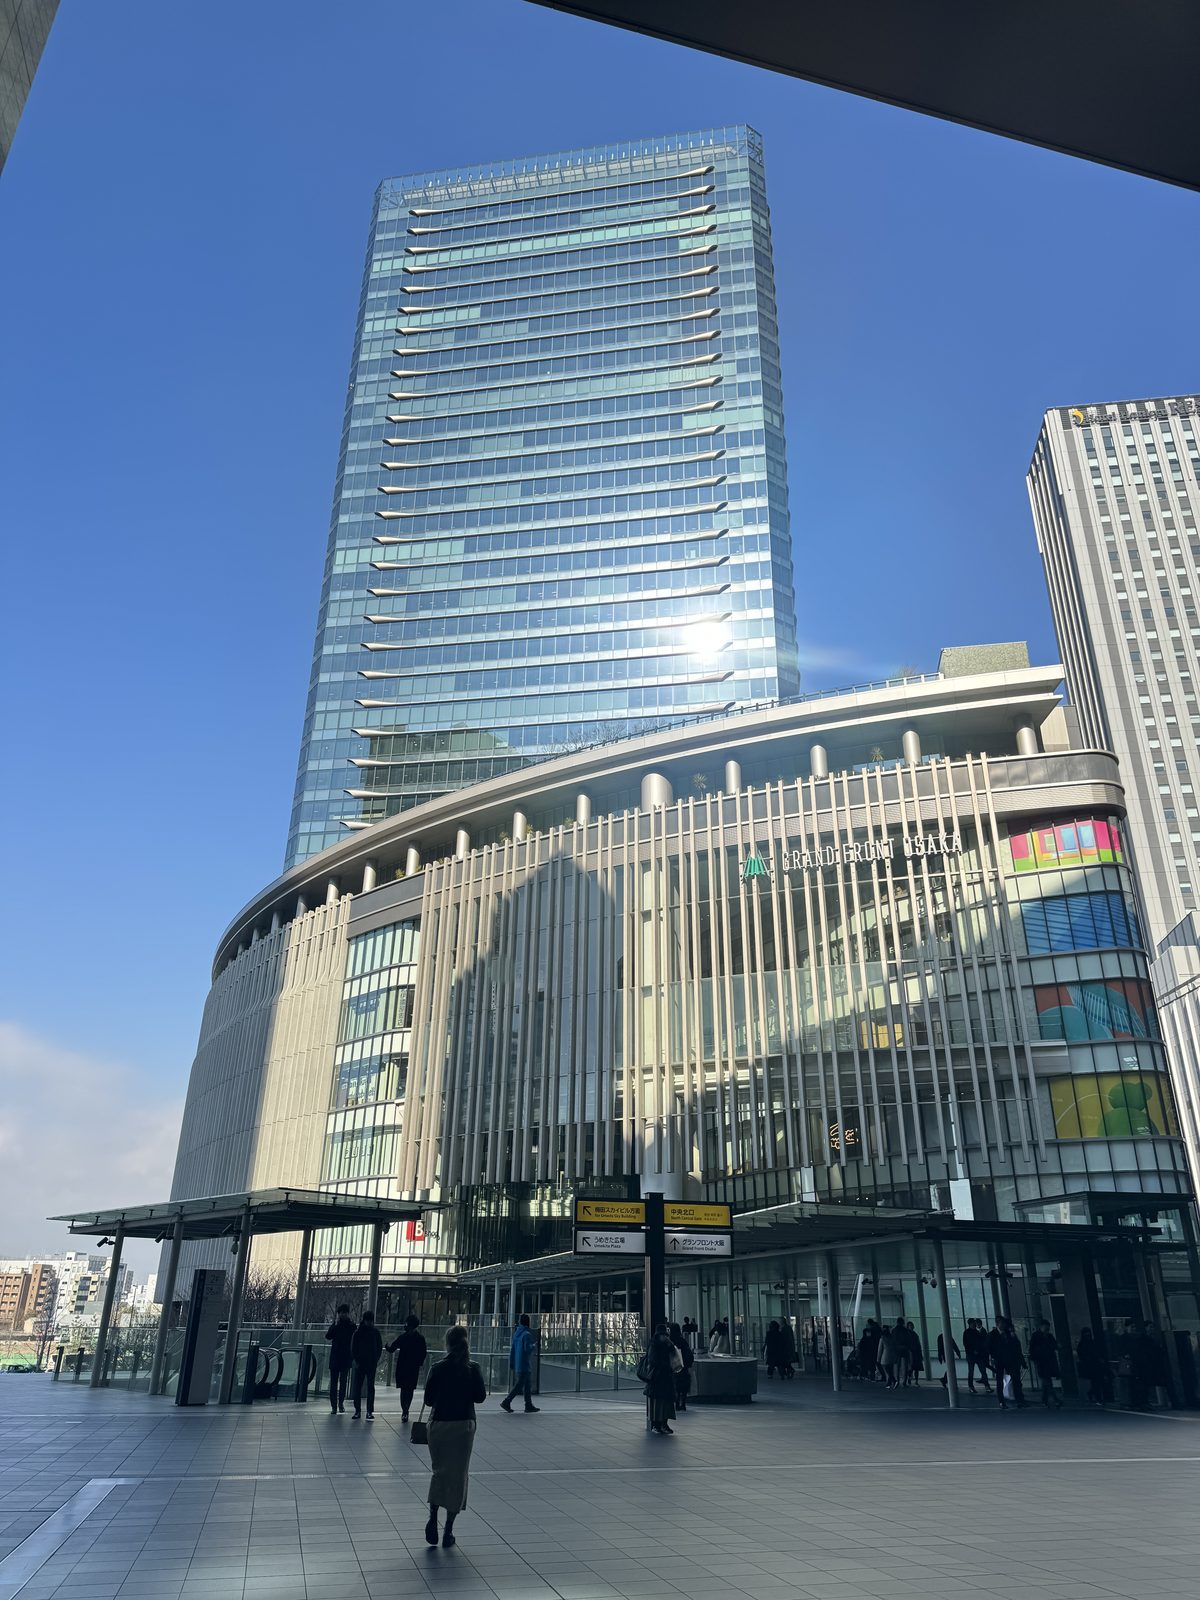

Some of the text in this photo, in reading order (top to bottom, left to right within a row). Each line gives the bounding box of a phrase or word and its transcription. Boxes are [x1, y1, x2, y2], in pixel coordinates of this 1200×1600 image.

[782, 832, 962, 871] GRAND FRONT OSAKA
